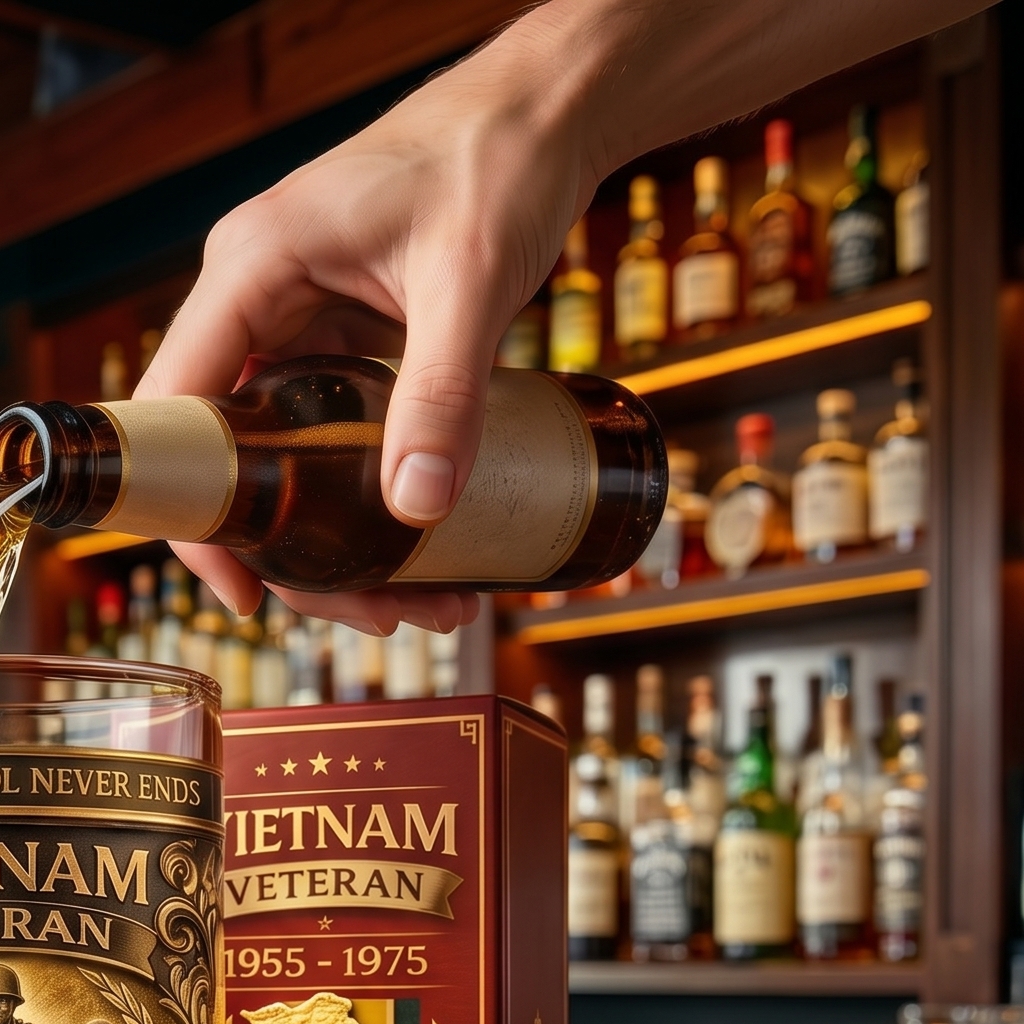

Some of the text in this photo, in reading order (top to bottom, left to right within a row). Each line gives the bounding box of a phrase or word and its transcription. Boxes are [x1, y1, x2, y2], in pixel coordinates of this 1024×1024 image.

[30, 767, 132, 798] NEVER
[138, 773, 201, 806] ENDS
[225, 868, 424, 906] VETERAN
[224, 947, 306, 978] 1955
[342, 946, 428, 976] 1975
